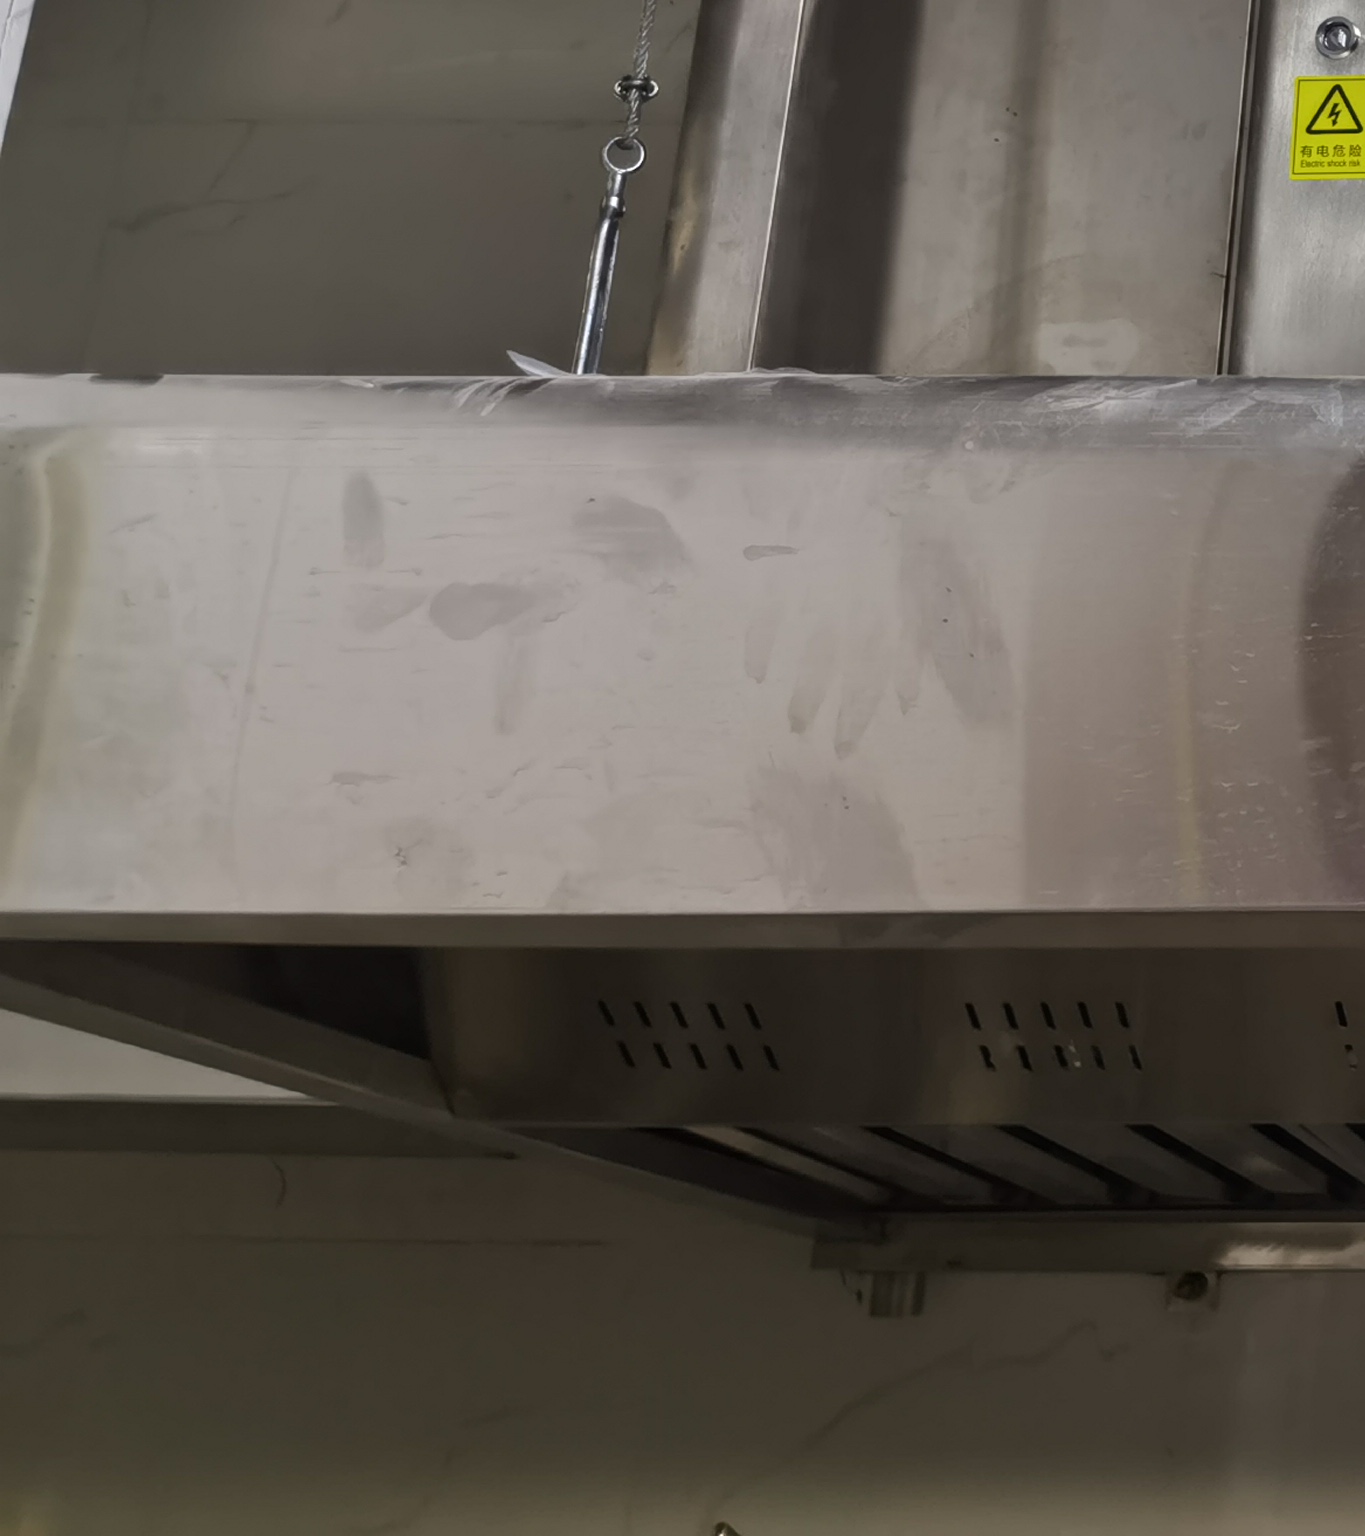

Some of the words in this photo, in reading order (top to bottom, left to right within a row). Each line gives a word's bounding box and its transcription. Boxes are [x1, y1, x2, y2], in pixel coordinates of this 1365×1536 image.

[1300, 143, 1362, 158] 有电危险
[1300, 160, 1326, 168] Electric
[1327, 159, 1347, 167] shock
[1349, 158, 1361, 167] risk
